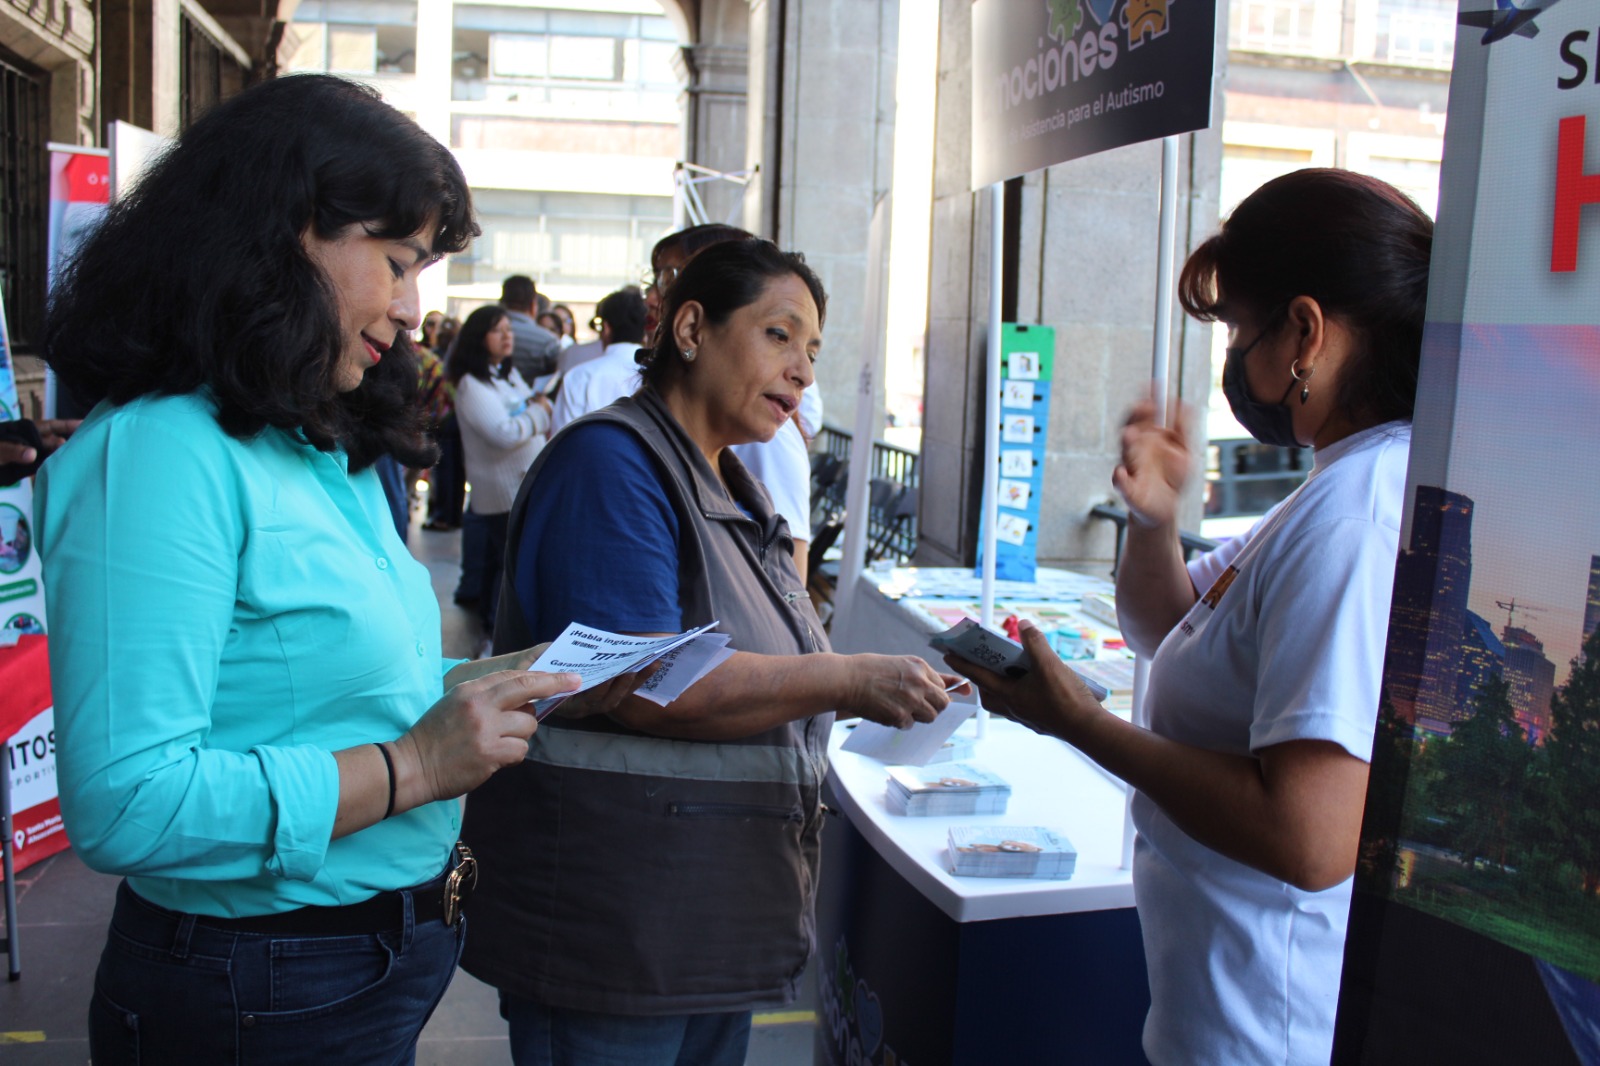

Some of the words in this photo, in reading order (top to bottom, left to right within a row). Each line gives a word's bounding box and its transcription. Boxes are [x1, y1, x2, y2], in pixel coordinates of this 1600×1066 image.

[1557, 28, 1600, 90] S
[1067, 103, 1090, 130] para
[1093, 94, 1104, 116] el
[1106, 81, 1165, 112] Autismo
[570, 631, 602, 642] ¡Habla
[604, 638, 632, 646] inglés
